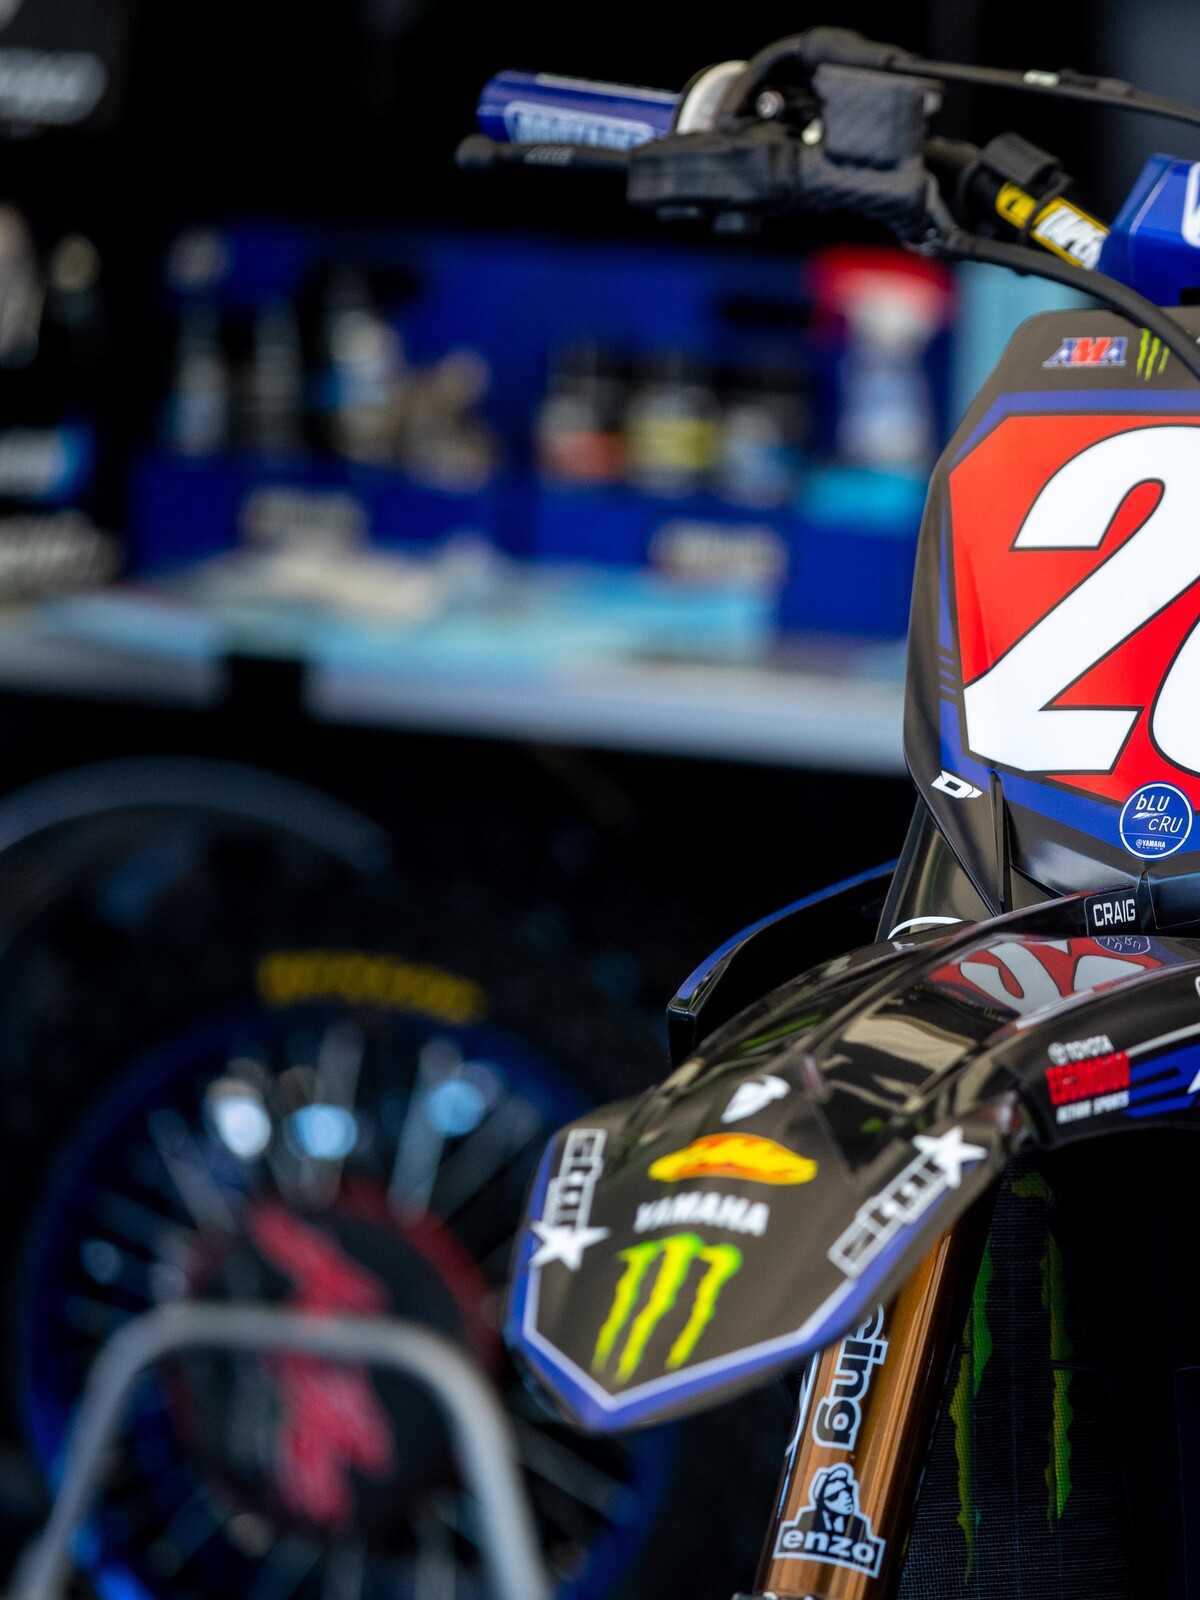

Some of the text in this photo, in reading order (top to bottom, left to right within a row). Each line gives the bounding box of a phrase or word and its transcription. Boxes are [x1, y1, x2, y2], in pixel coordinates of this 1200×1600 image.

[1042, 336, 1129, 368] AMA
[1142, 839, 1166, 849] YAMAHA
[1092, 898, 1136, 927] CRAIG
[782, 1529, 877, 1564] enzo
